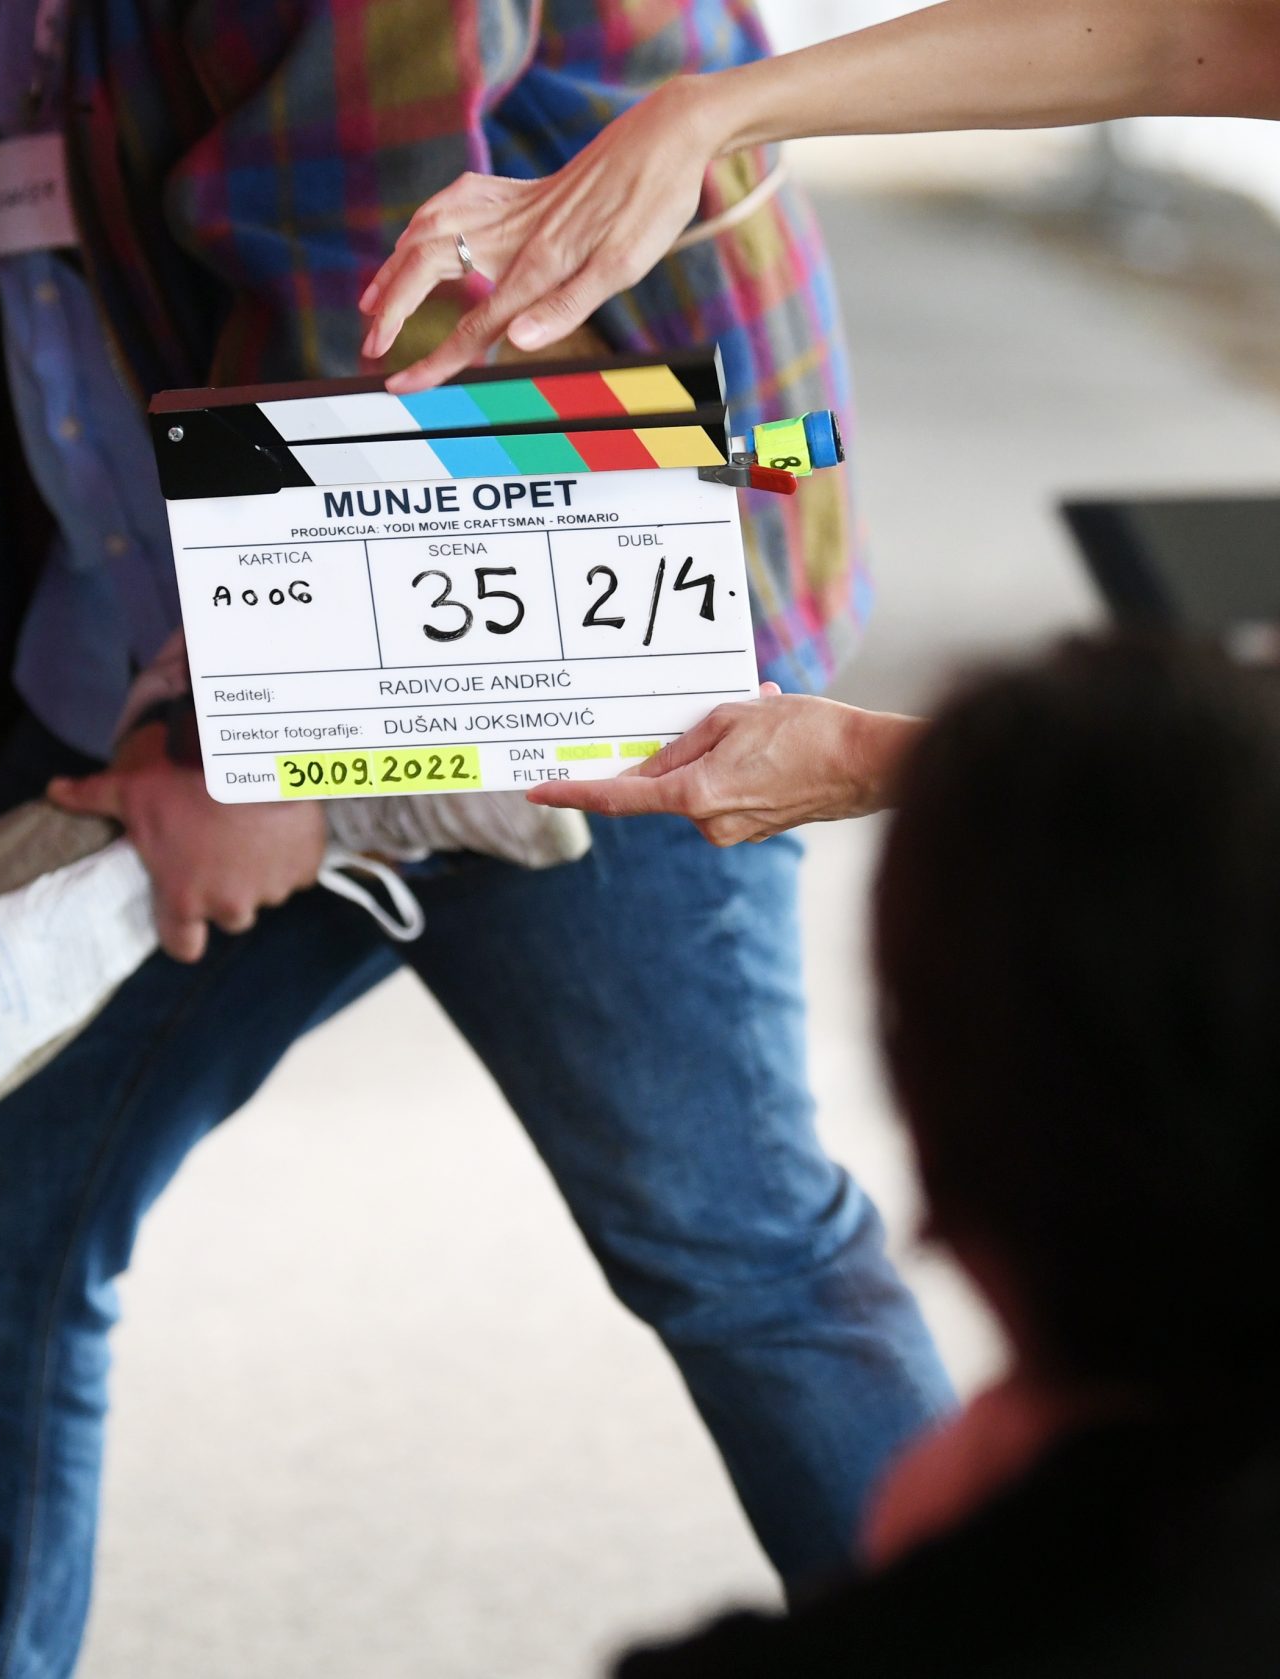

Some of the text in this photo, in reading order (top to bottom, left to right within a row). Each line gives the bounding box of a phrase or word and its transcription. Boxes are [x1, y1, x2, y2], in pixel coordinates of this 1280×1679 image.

[323, 479, 577, 518] MUNJE OPET
[290, 524, 380, 538] PRODUKCIJA:
[383, 522, 415, 534] YODI
[418, 519, 460, 532] MOVIE
[463, 515, 545, 530] CRAFTSMAN
[556, 512, 619, 525] ROMARIO
[617, 533, 663, 548] DUBL
[427, 541, 488, 557] SCENA
[238, 550, 313, 566] KARTICA
[411, 566, 525, 643] 35
[378, 669, 572, 696] RADIVOJE ANDRIĆ
[213, 688, 275, 703] Reditelj:
[383, 707, 596, 735] DUŠAN JOKSIMOVIĆ
[219, 723, 363, 742] Direktor fotografije:
[509, 747, 545, 761] DAN
[225, 771, 276, 784] Datum
[512, 767, 570, 782] FILTER
